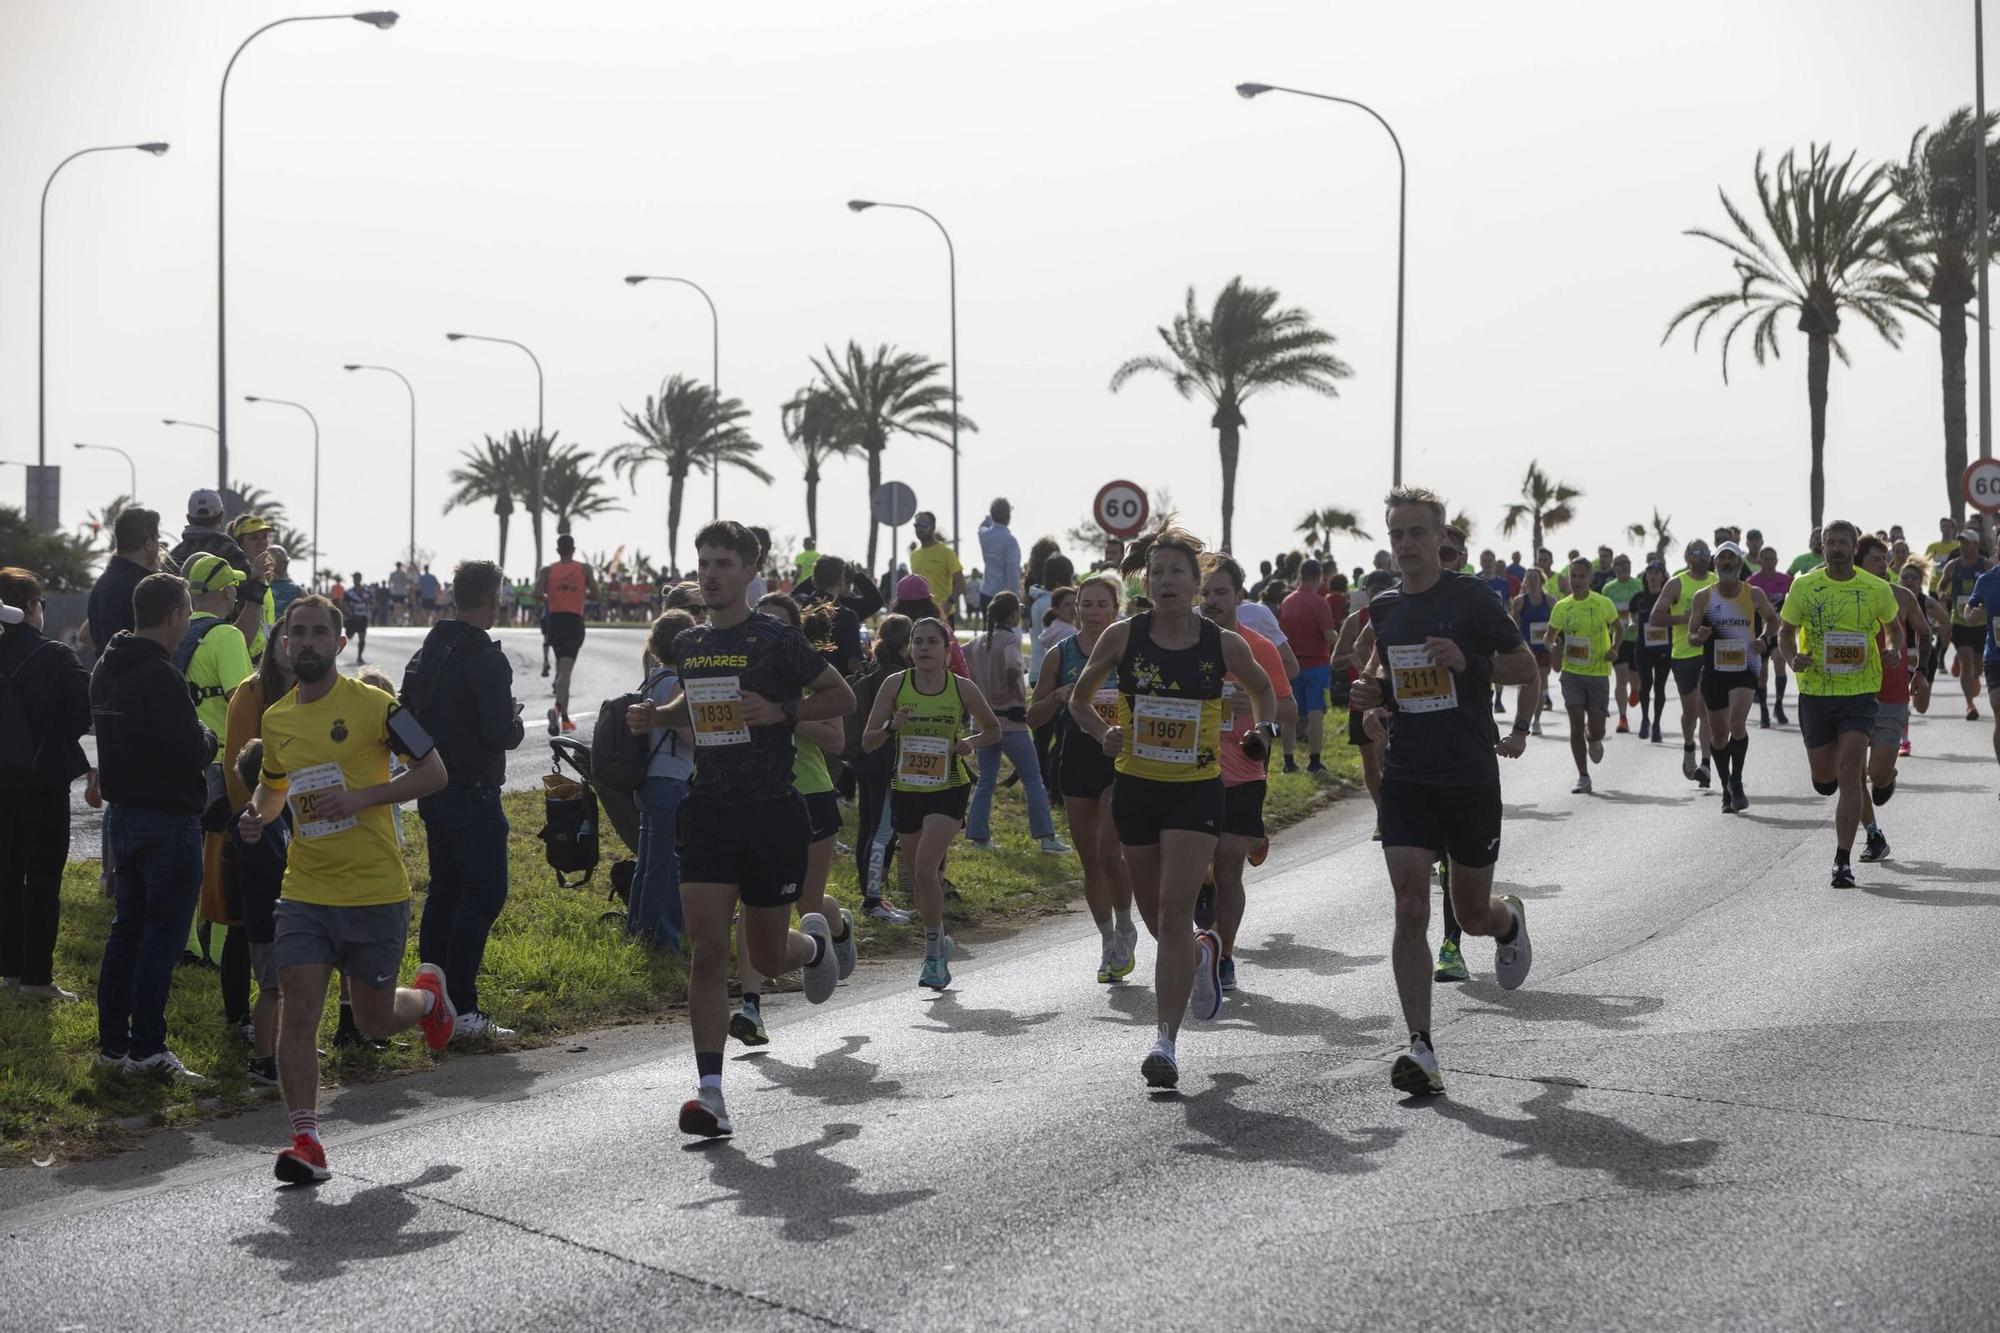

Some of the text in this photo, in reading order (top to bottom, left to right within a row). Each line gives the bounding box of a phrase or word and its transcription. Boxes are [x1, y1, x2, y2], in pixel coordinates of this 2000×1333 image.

[1106, 499, 1138, 518] 60
[684, 655, 748, 669] PAPARRES
[1833, 647, 1860, 659] 2680
[1402, 668, 1439, 689] 2111
[700, 704, 733, 723] 1833
[1149, 720, 1187, 739] 1967
[909, 754, 938, 769] 2397
